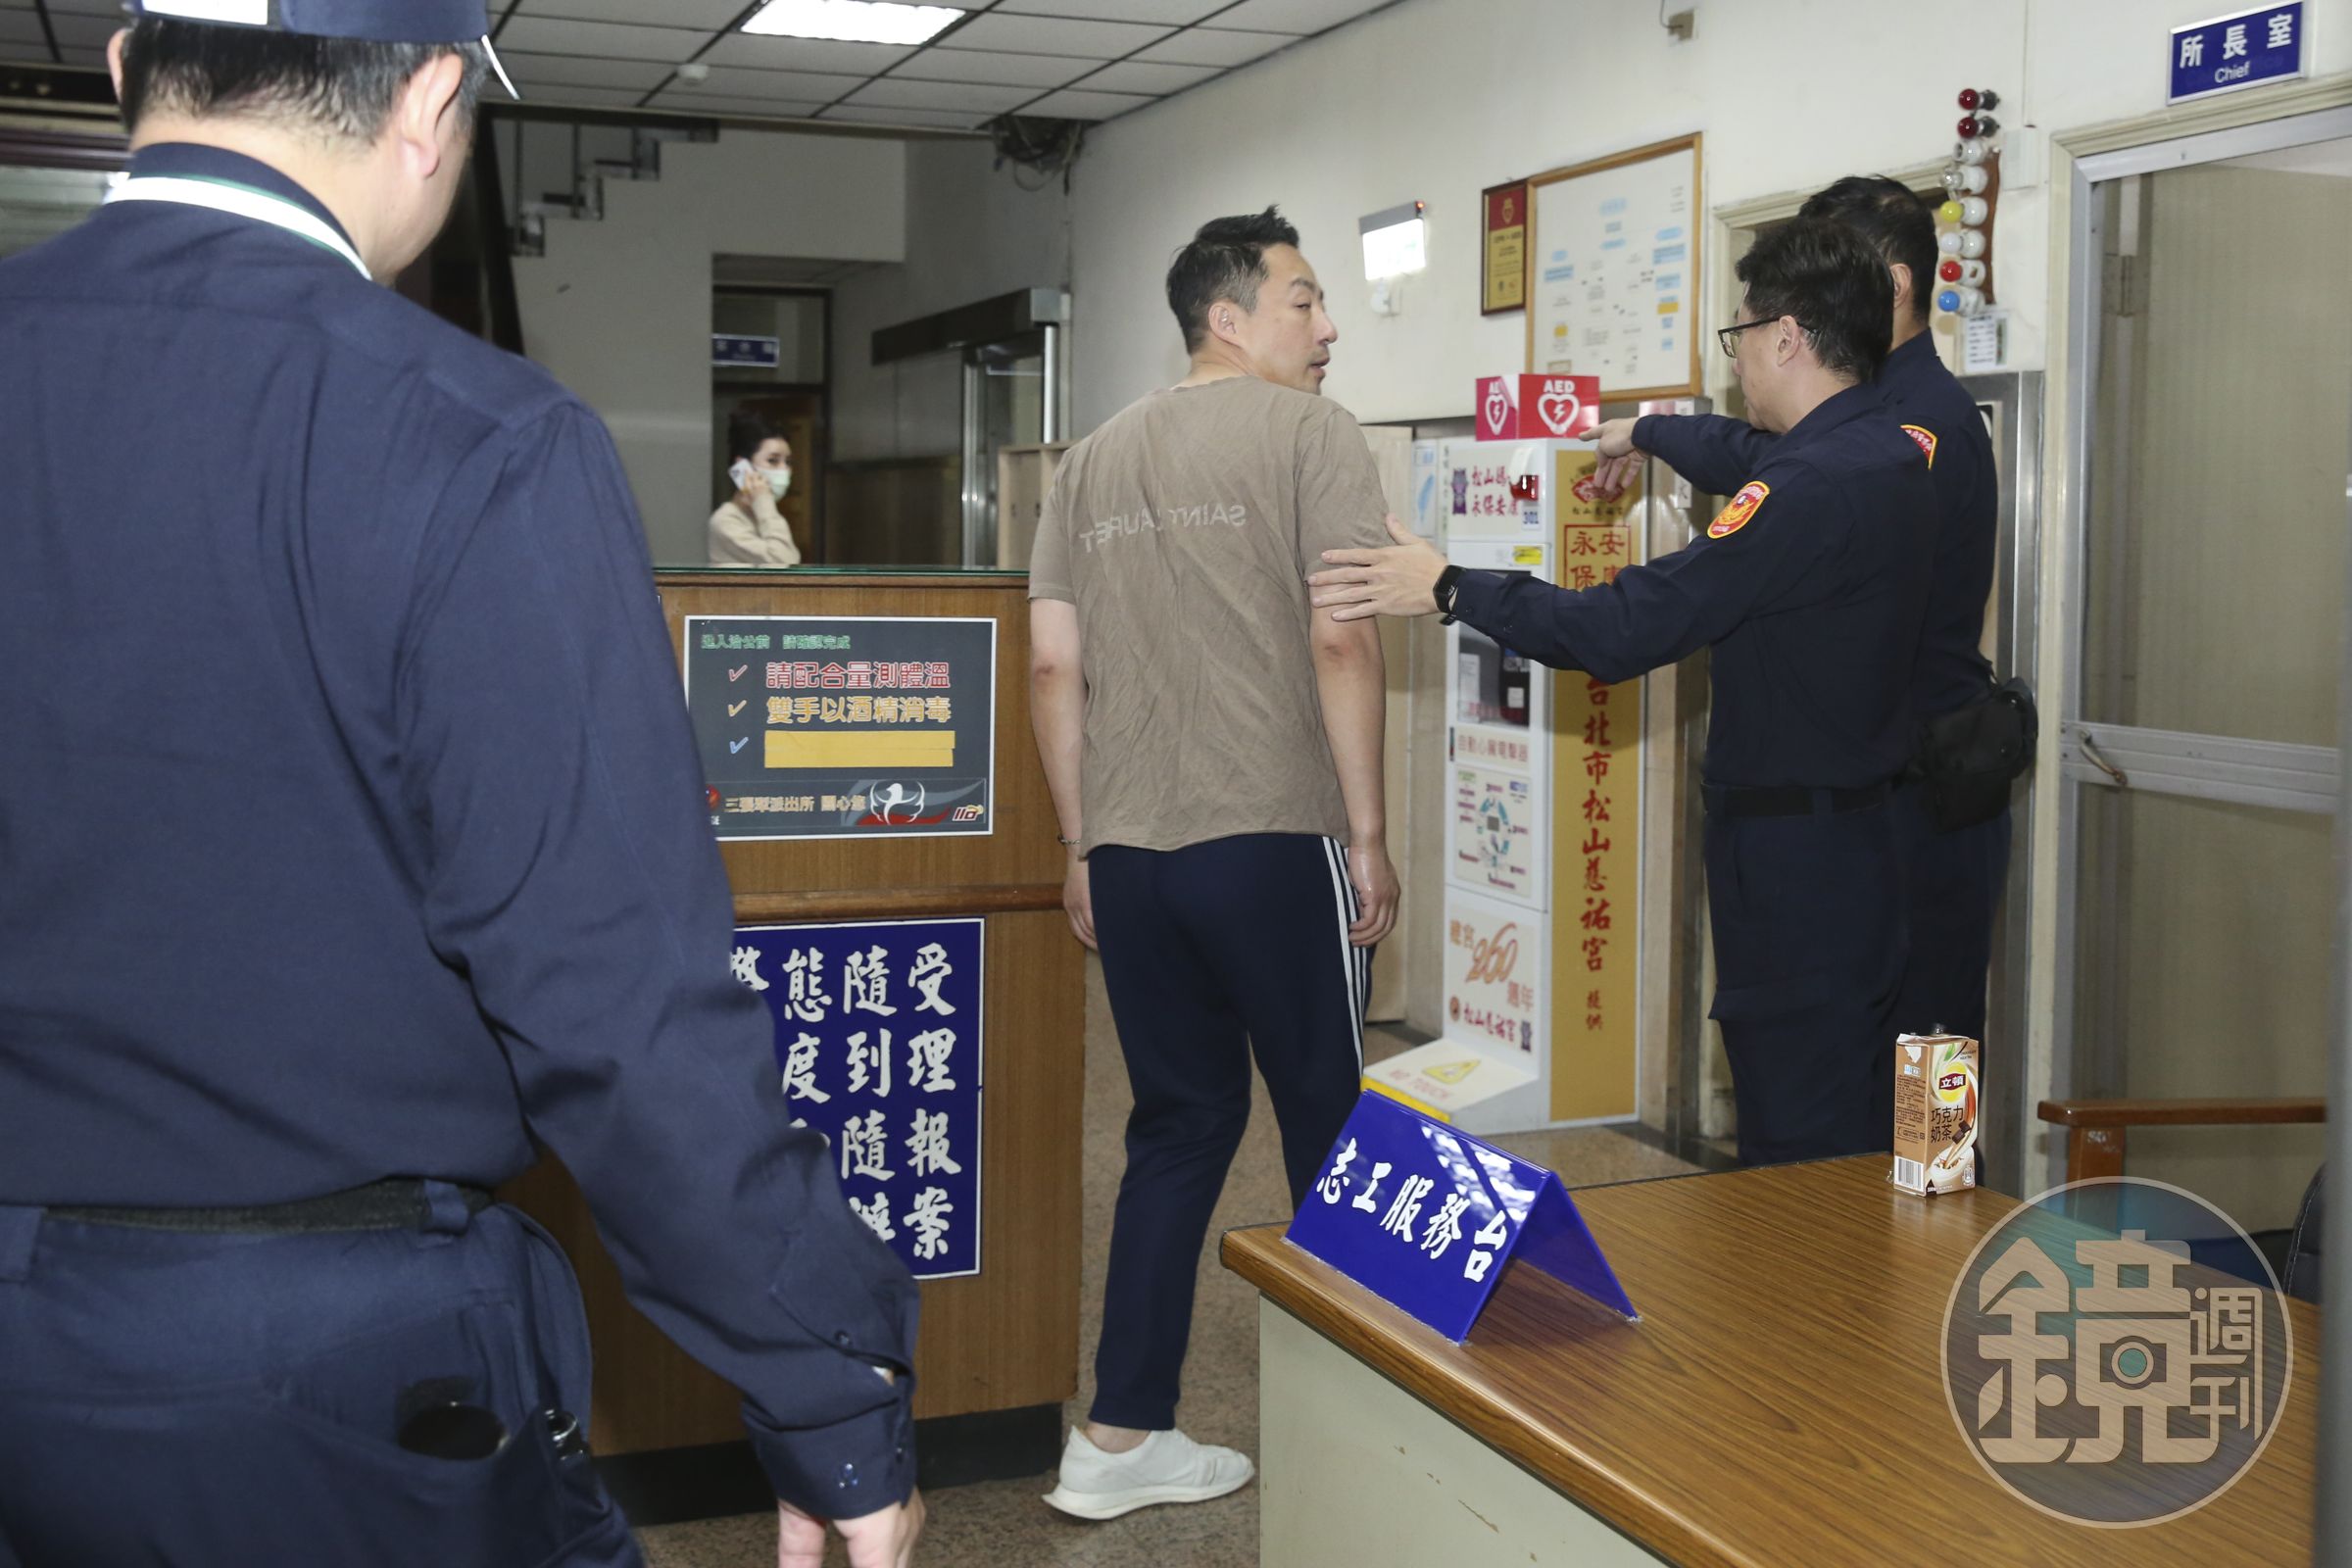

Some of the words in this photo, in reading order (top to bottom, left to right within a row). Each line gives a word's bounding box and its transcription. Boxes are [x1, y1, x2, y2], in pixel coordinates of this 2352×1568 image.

[2179, 14, 2293, 70] 所長室
[2215, 61, 2251, 83] Chief
[1544, 380, 1575, 394] AED
[765, 662, 951, 689] 請配合量測體溫
[765, 696, 952, 723] 雙手以酒精消毒
[1940, 1075, 1965, 1089] 立頓
[903, 942, 962, 1260] 受理報案
[1931, 1105, 1964, 1125] 巧克力
[1931, 1124, 1952, 1144] 奶茶
[1316, 1137, 1508, 1283] 志工服務台
